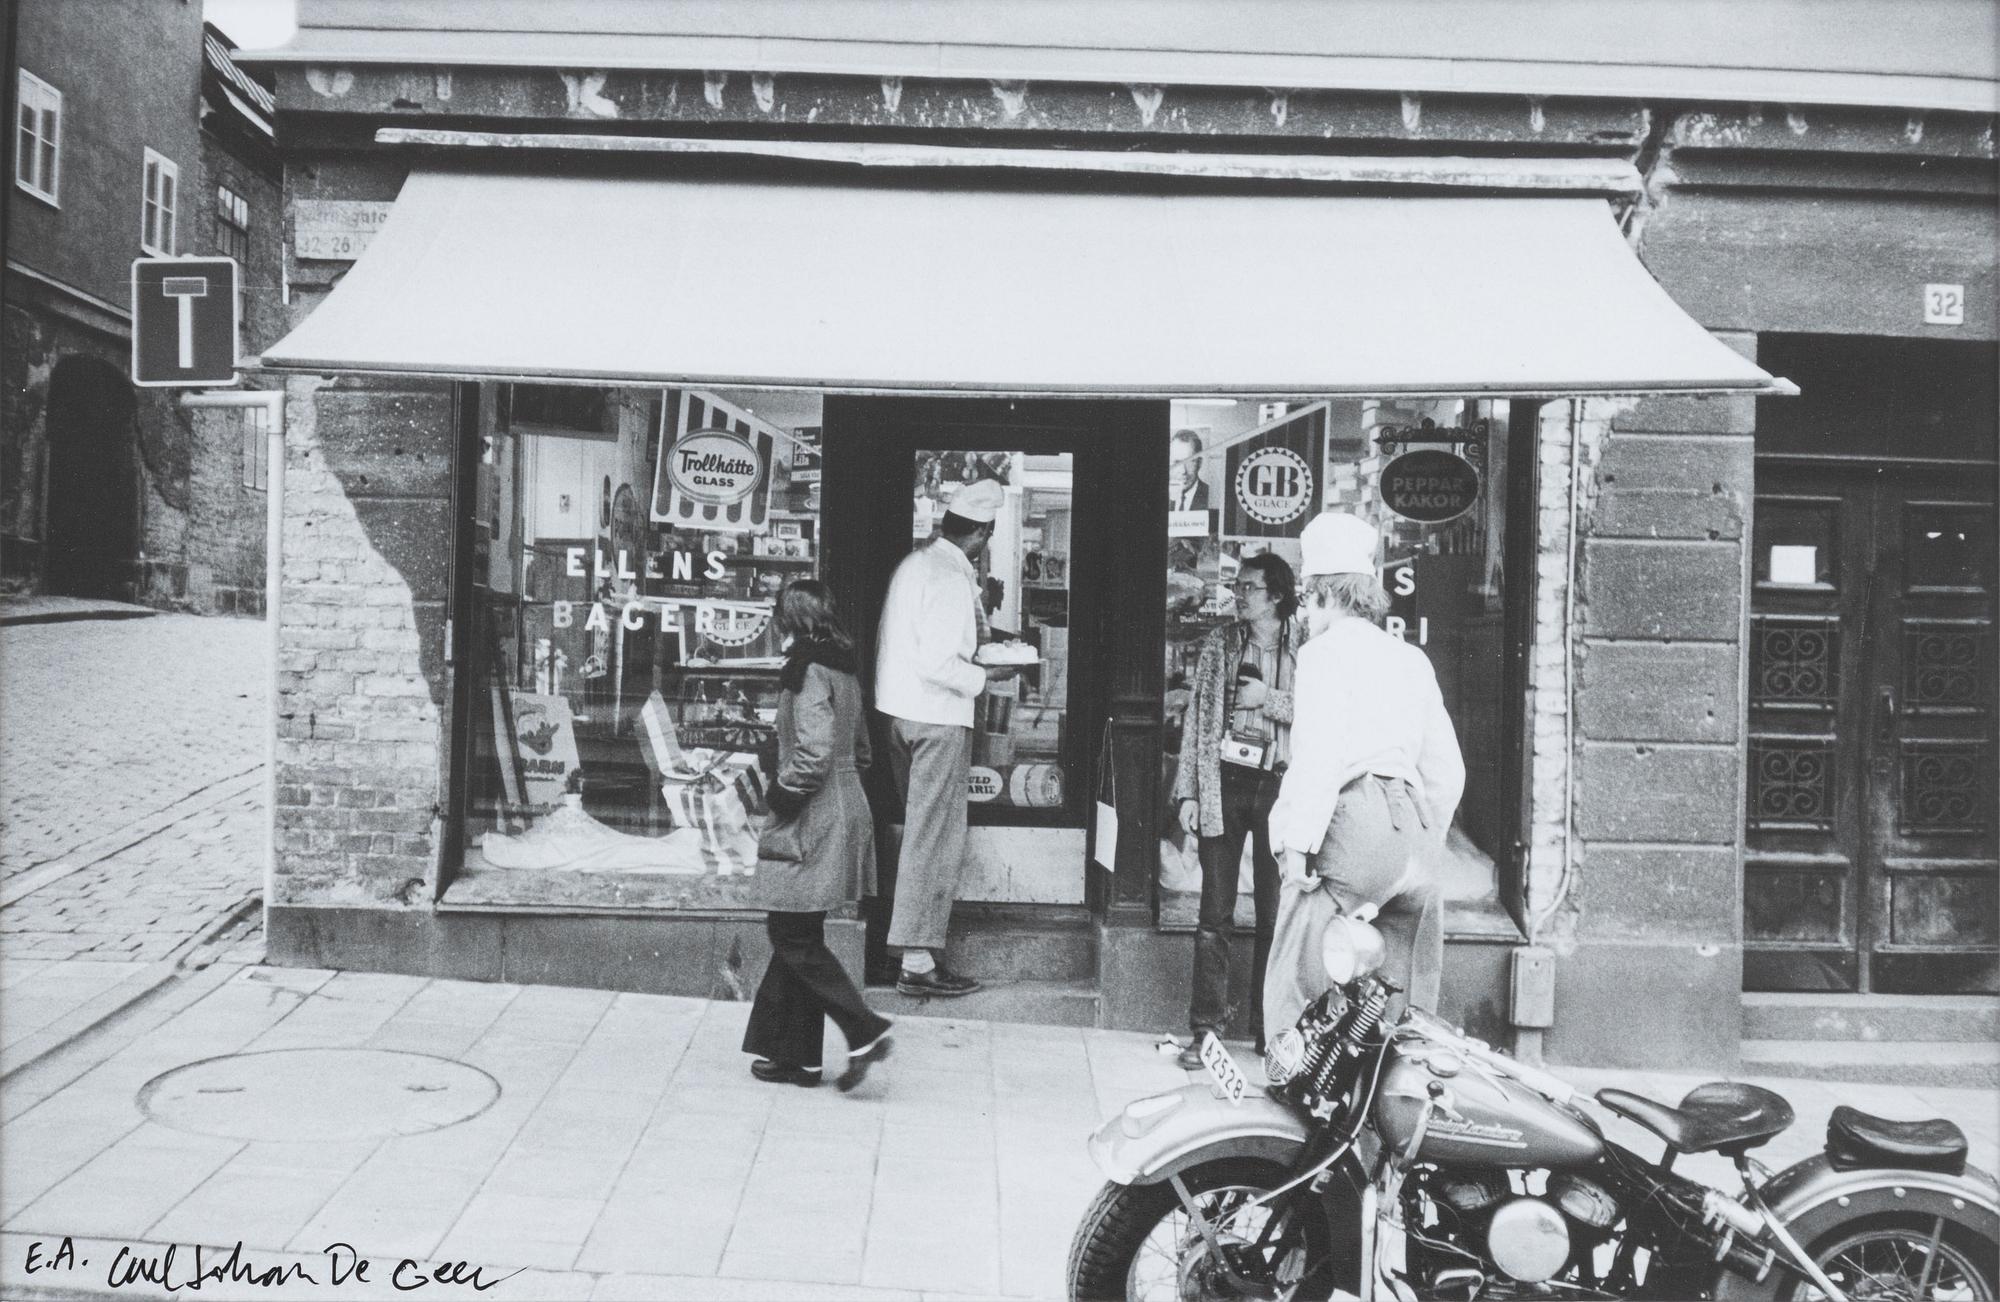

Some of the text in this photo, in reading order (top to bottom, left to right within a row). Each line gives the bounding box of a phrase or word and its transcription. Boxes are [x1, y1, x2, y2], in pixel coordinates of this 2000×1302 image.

[1931, 292, 1958, 317] 32
[678, 449, 754, 476] Trollhätte
[693, 475, 735, 488] GLASS
[1248, 464, 1300, 497] GB
[1392, 476, 1465, 492] PEPPAR
[1254, 498, 1292, 509] GLACE
[1394, 493, 1462, 509] KAKOR
[566, 547, 728, 581] ELLENS
[553, 602, 737, 633] BAGERI
[713, 621, 752, 631] GLCE
[968, 776, 991, 784] ULD
[968, 785, 996, 794] ARIE
[325, 1242, 371, 1286] De
